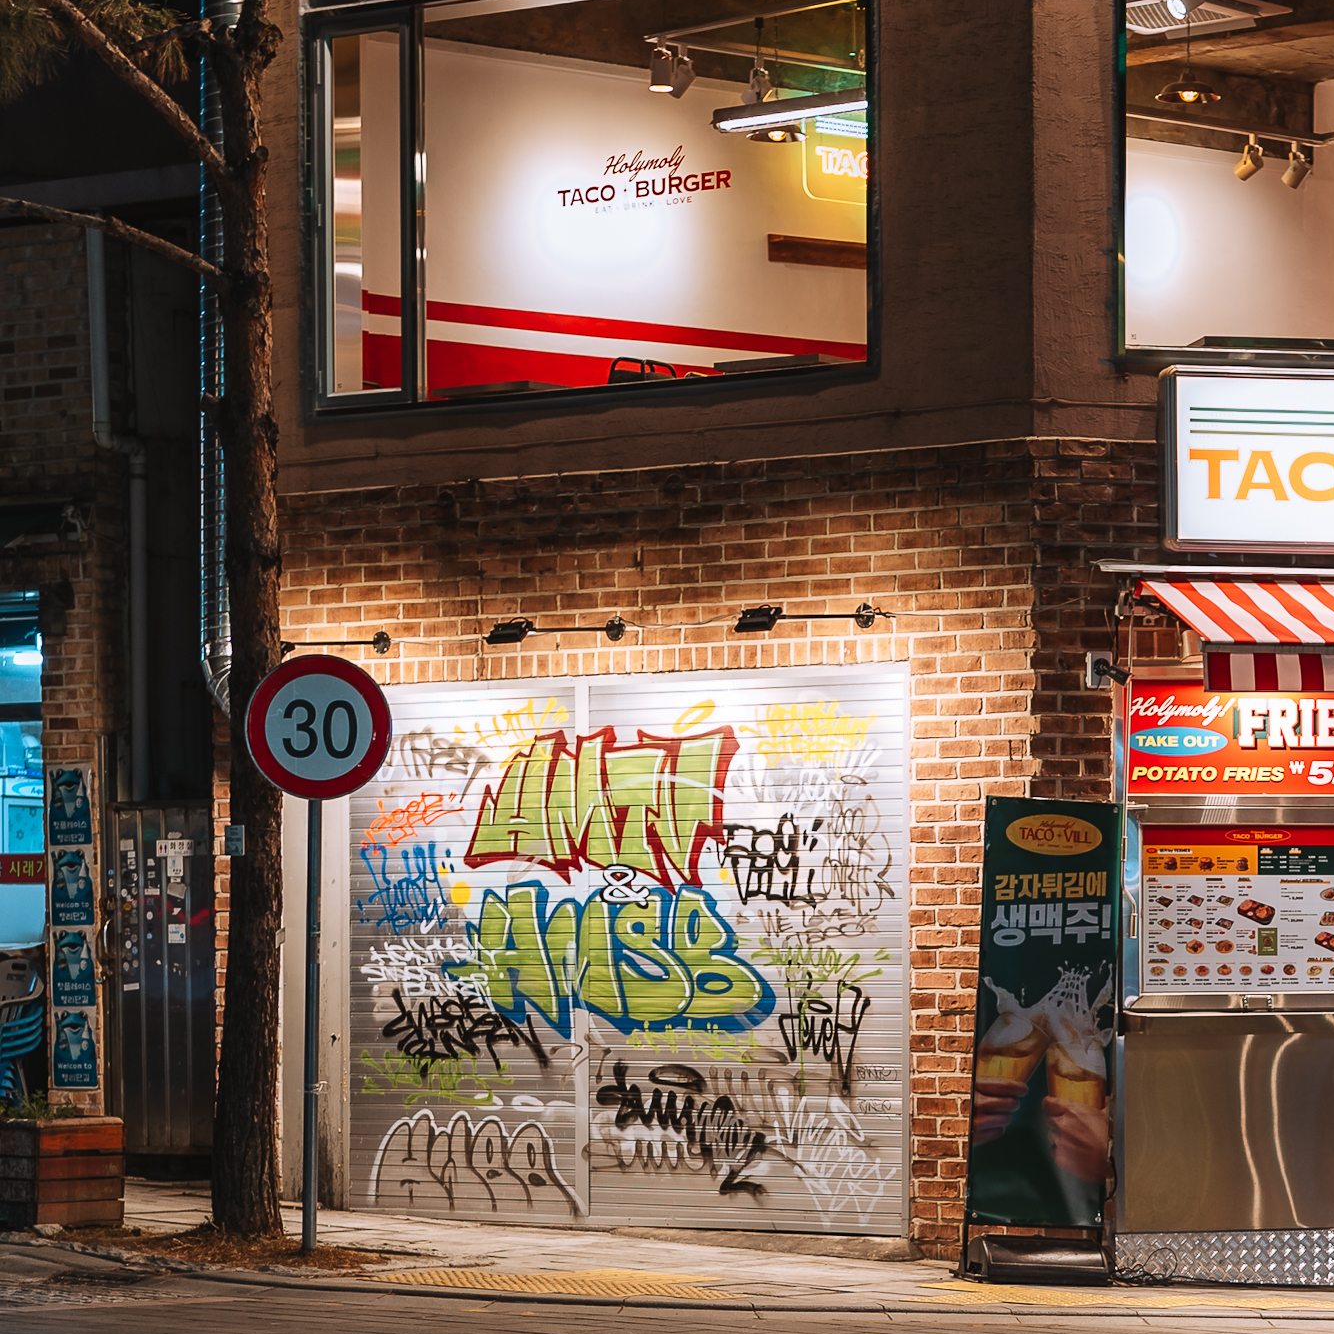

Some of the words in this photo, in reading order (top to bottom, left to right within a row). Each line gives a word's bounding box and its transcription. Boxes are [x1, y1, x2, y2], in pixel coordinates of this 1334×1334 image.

[603, 144, 686, 182] Holymoly
[557, 184, 616, 207] TACO
[635, 169, 732, 199] BURGER
[666, 195, 693, 206] LOVE
[1129, 695, 1237, 726] Holymoly!
[282, 698, 358, 759] 30
[1135, 734, 1179, 749] TAKE
[1182, 733, 1220, 748] OUT
[1131, 766, 1218, 783] POTATO
[1221, 765, 1285, 783] FRIES
[1019, 826, 1055, 842] TACO
[1063, 829, 1093, 844] VILL
[994, 871, 1107, 901] 감자튀김에
[990, 902, 1112, 947] 생맥주!
